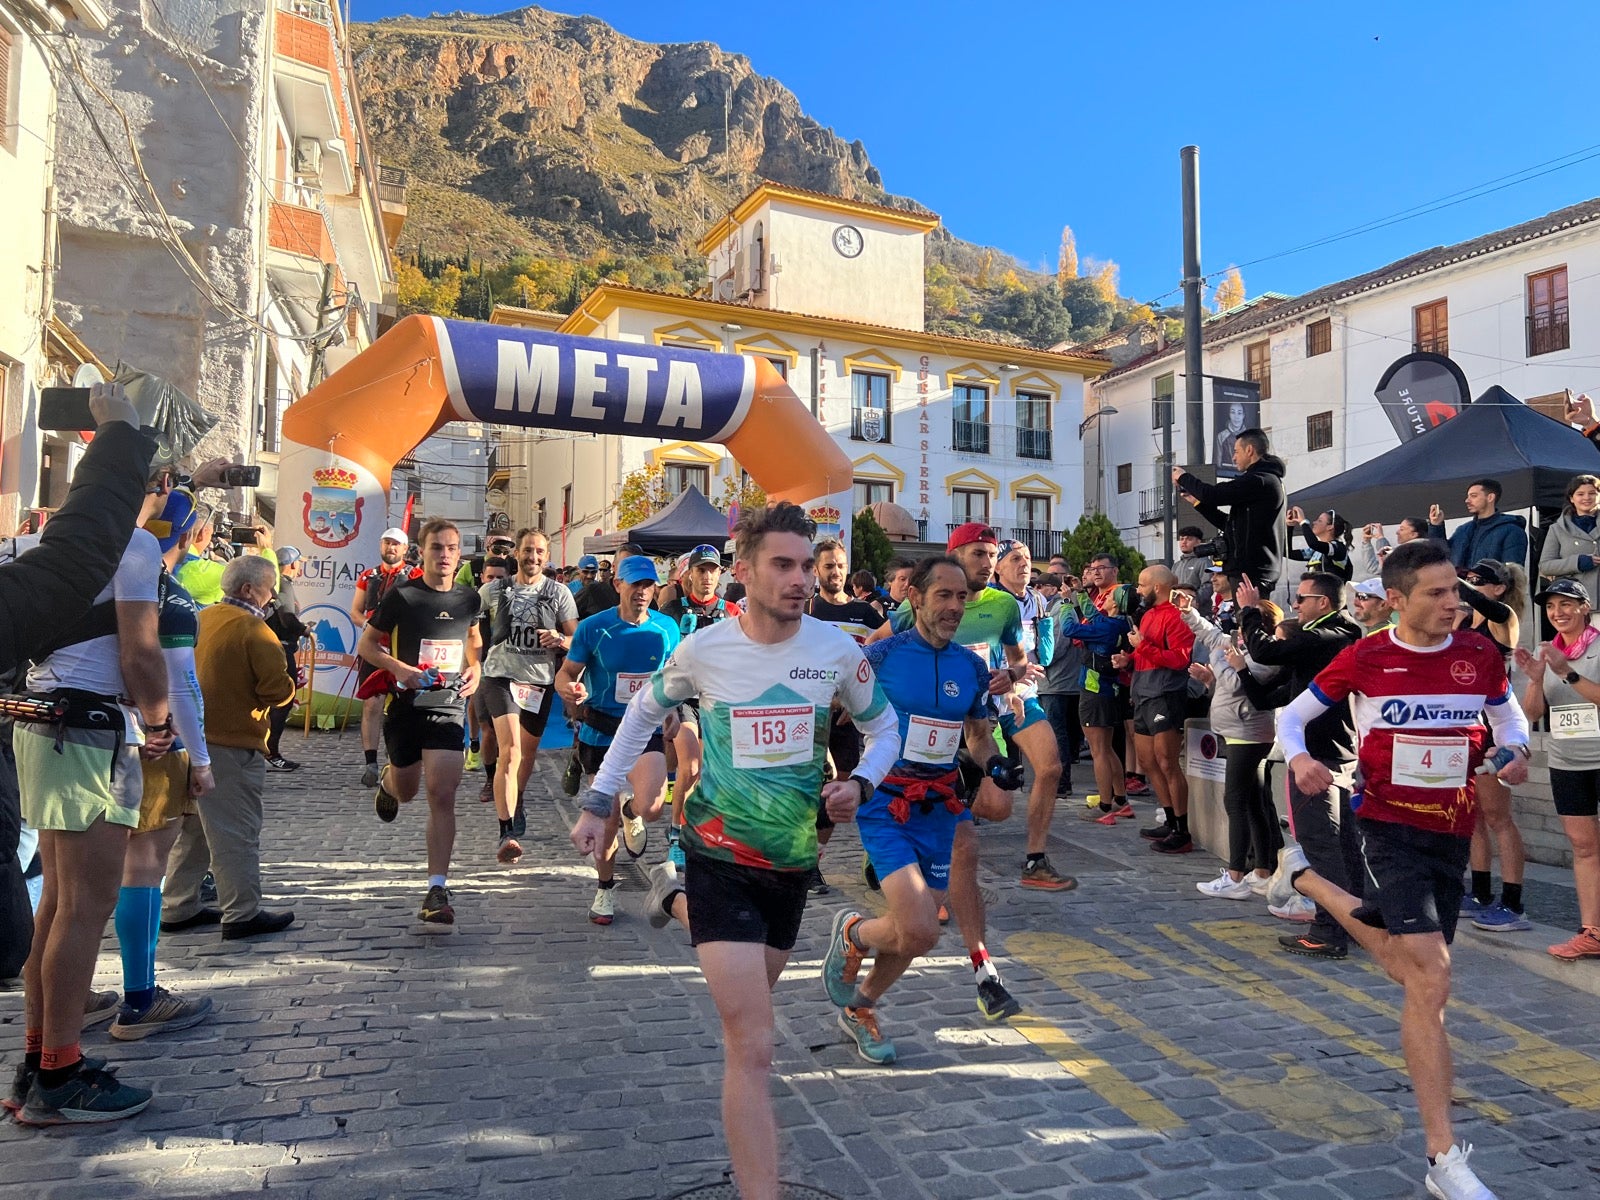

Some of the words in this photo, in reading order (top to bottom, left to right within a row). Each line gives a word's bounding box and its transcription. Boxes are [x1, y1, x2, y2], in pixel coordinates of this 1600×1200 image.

[494, 339, 703, 429] META
[919, 439, 930, 518] SIERRA
[296, 555, 366, 596] ÜÉJAR
[434, 647, 447, 661] 73
[789, 666, 838, 681] datacor
[518, 688, 529, 701] 84
[1559, 712, 1580, 727] 293
[751, 719, 786, 746] 153
[927, 729, 938, 747] 6
[1420, 749, 1433, 769] 4
